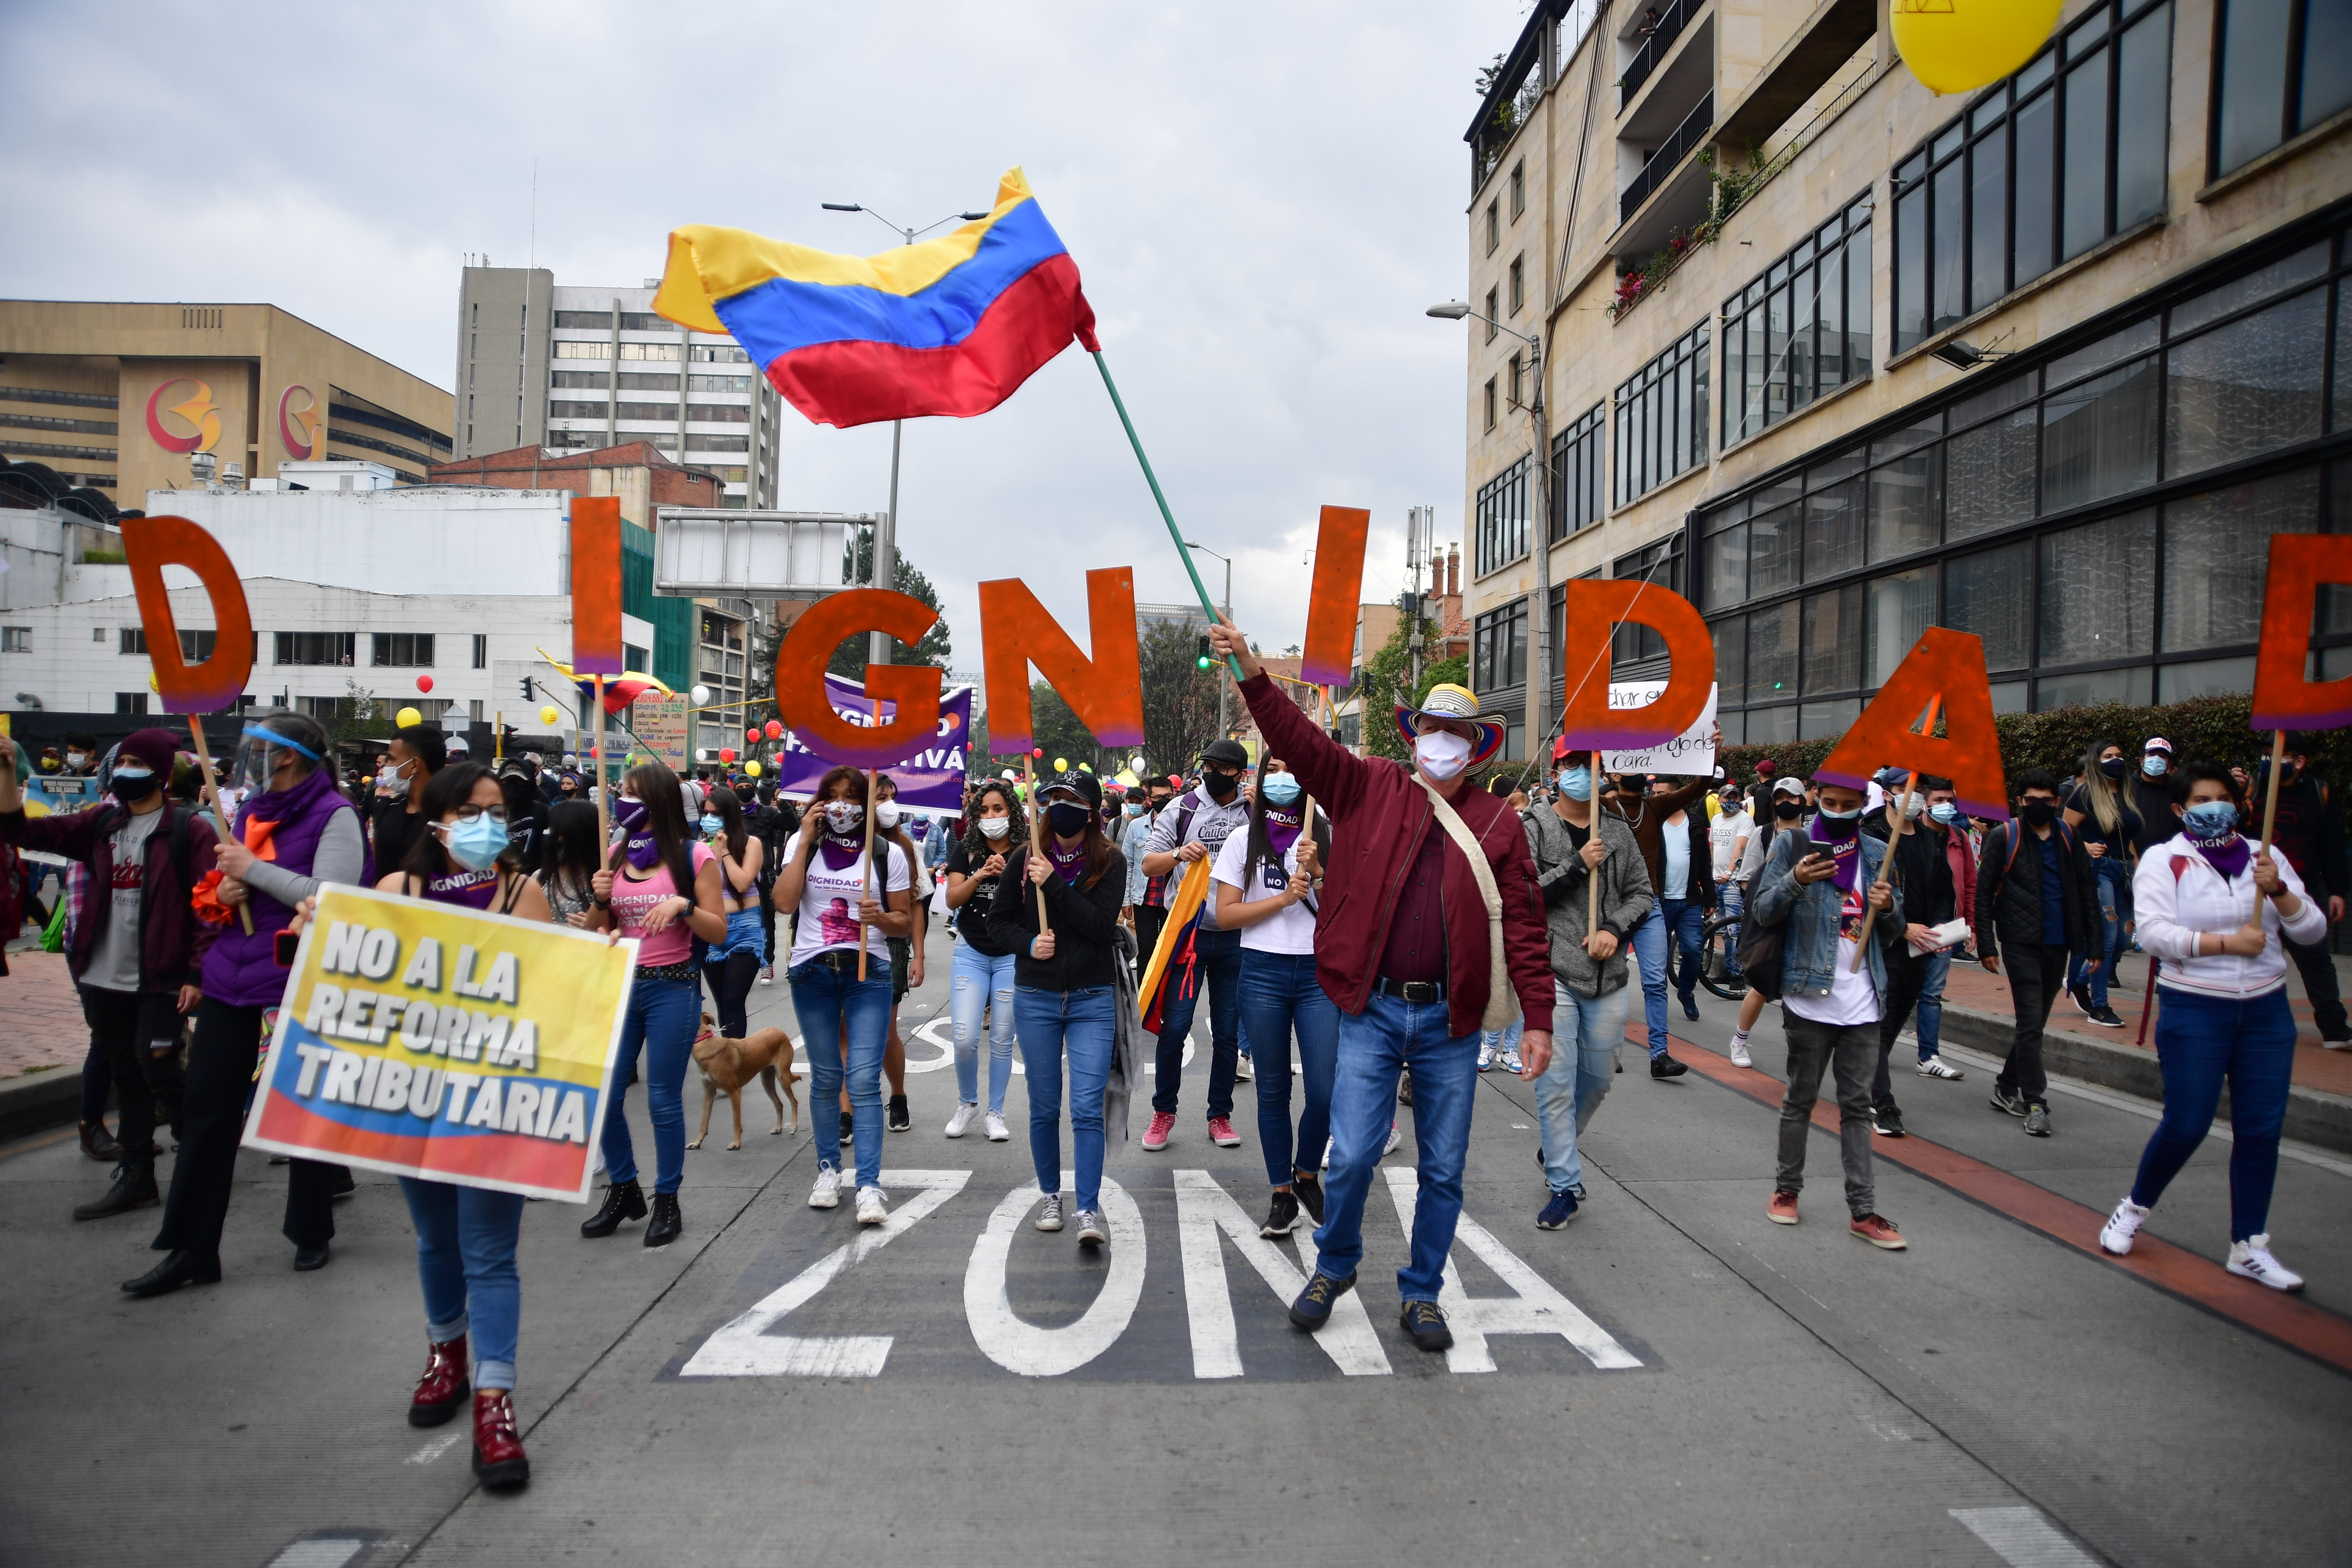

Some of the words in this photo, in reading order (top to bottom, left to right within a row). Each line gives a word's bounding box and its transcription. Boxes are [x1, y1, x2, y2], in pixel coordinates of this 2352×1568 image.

[1667, 737, 1691, 758] ojo
[891, 772, 962, 783] www.dignidad.co
[621, 807, 643, 825] DIGNIDAD
[1204, 817, 1221, 825] FINEST
[429, 868, 496, 891] IGNIDAD
[808, 874, 860, 887] DIGNIDAD
[1268, 878, 1282, 886] NO
[321, 920, 396, 979] NO
[402, 936, 440, 989] A
[451, 945, 517, 1003] LA
[304, 983, 536, 1070] REFORMA
[296, 1043, 585, 1143] TRIBUTARIA
[679, 1168, 1642, 1378] ZONA
